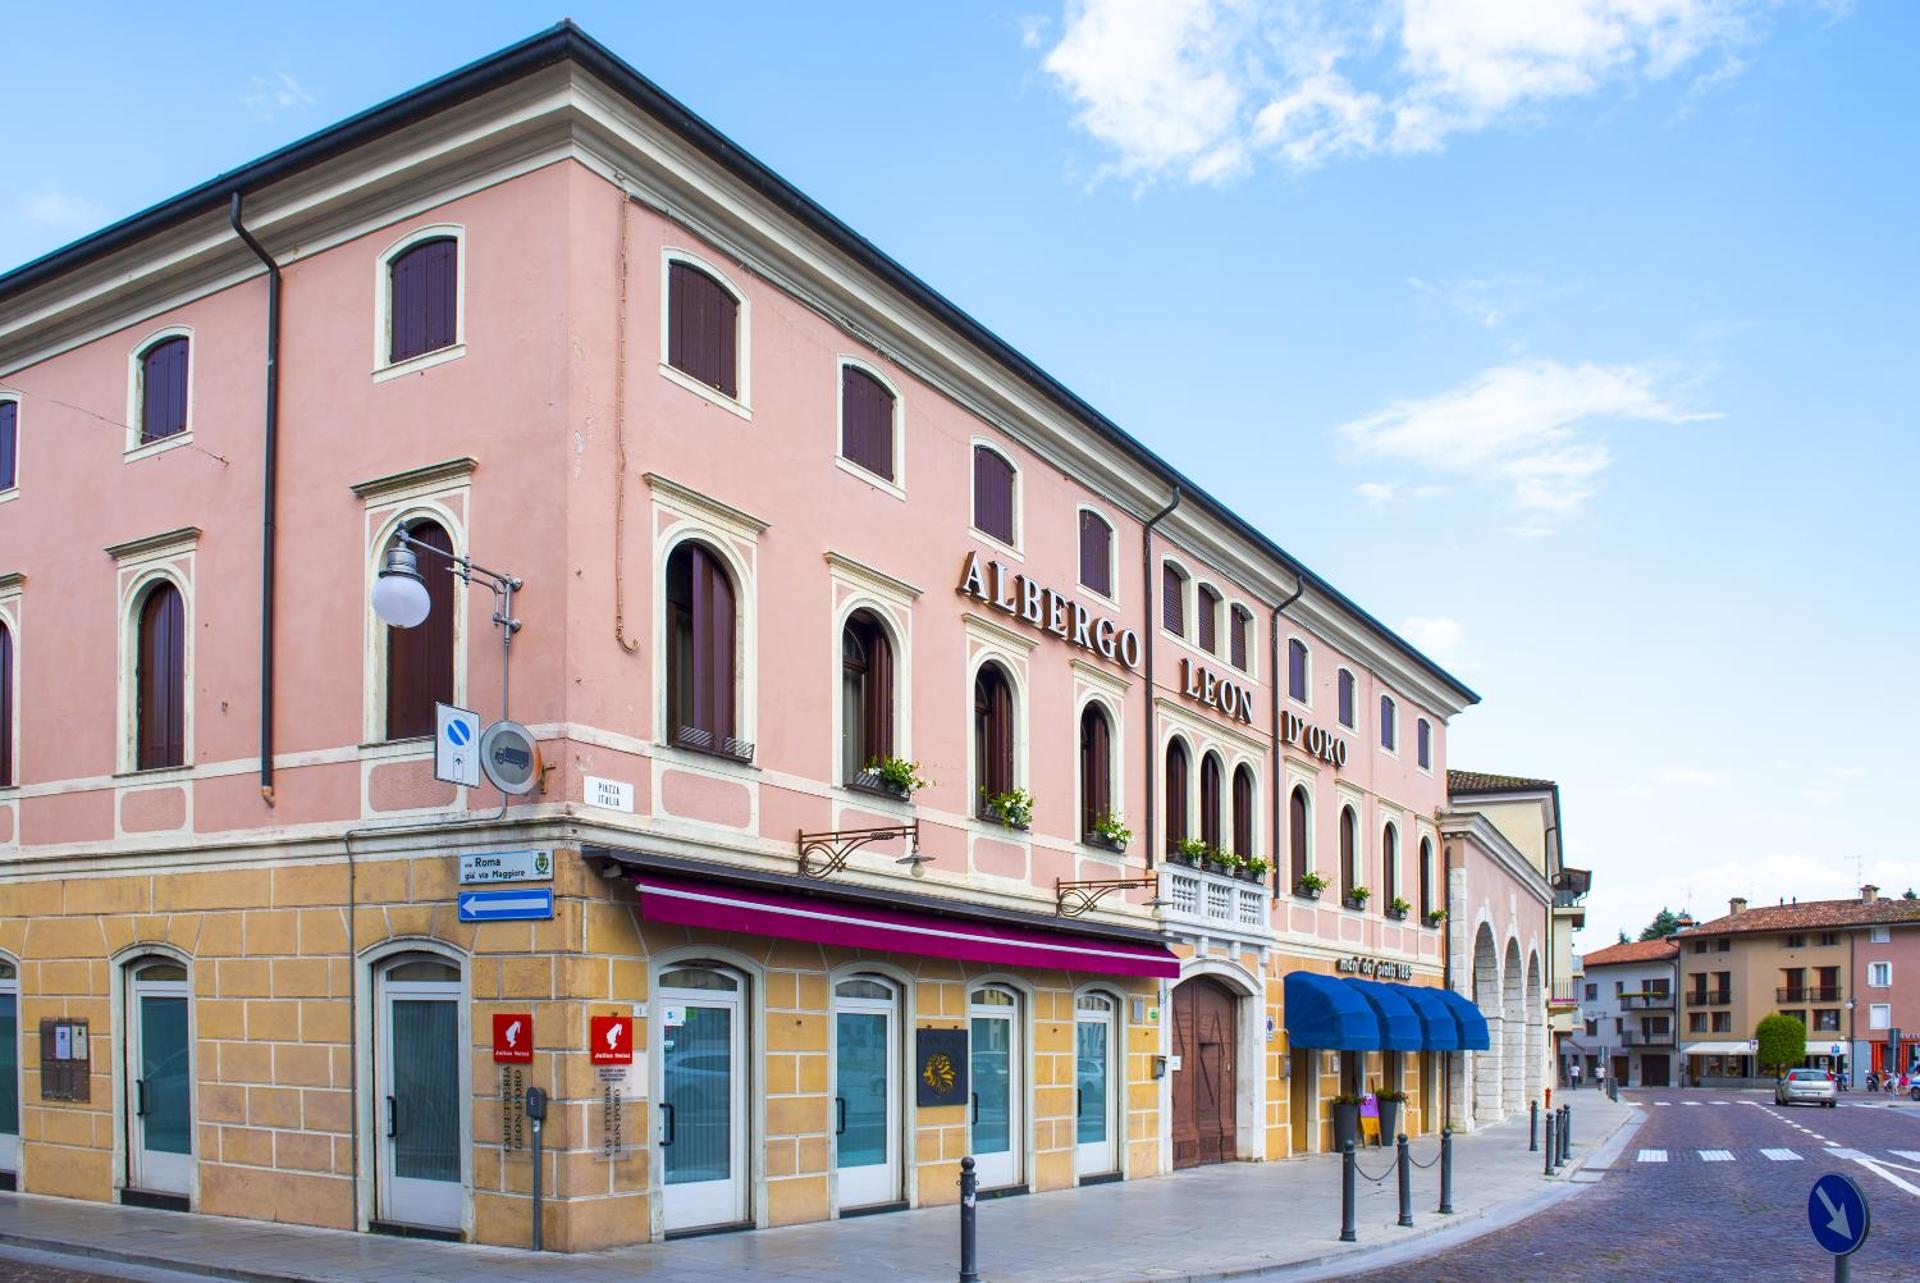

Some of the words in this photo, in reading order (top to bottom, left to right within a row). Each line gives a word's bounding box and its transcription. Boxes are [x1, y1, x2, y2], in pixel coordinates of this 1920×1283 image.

[956, 550, 1142, 669] ALBERGO
[1179, 657, 1252, 725] LEON
[1280, 710, 1348, 768] D'ORO
[598, 782, 620, 794] PIAZZA
[598, 794, 620, 806] ITALIA
[475, 857, 501, 868] Roma
[478, 871, 489, 879] via
[492, 869, 526, 879] Maggiore
[514, 1070, 522, 1110] D'ORO
[503, 1066, 512, 1153] CAFFETTERIA
[514, 1113, 522, 1150] LEON
[614, 1123, 622, 1153] LEON
